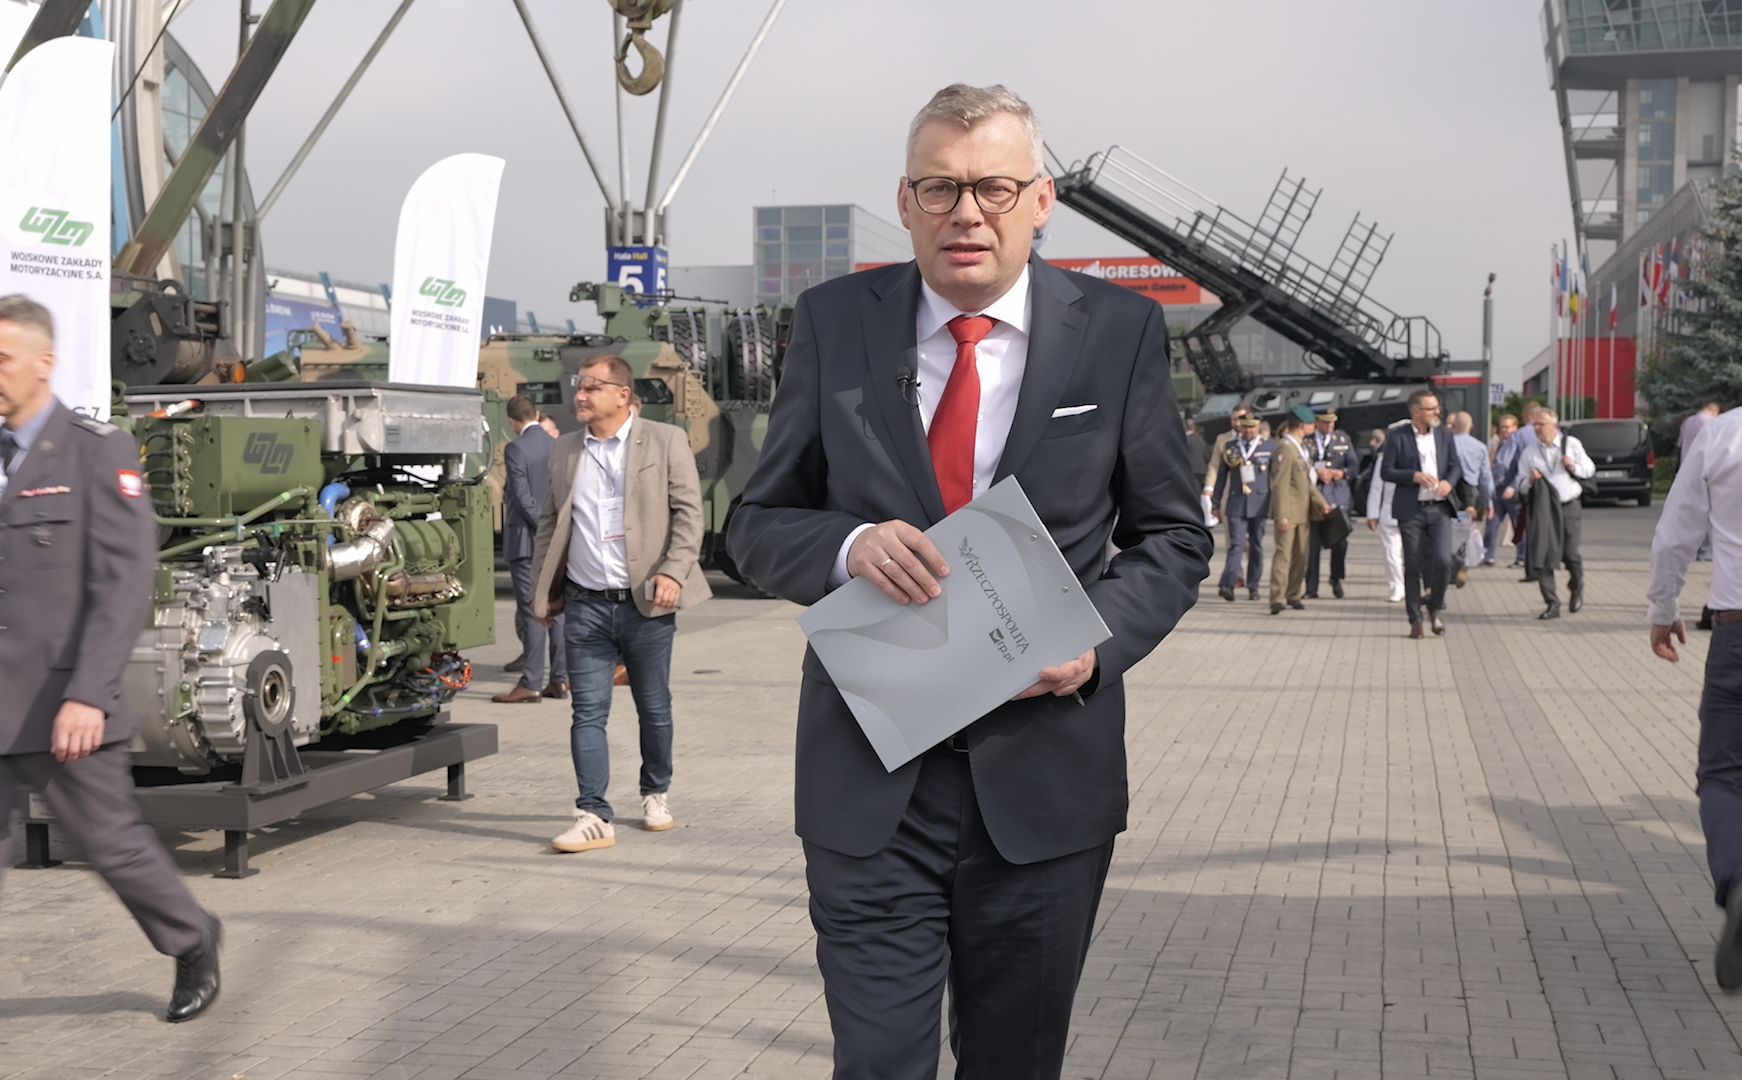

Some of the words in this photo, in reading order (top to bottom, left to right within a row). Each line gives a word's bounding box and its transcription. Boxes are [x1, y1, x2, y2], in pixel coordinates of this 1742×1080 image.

[11, 251, 58, 264] WOJSKOWE
[61, 256, 102, 268] ZAKŁADY
[10, 264, 83, 278] MOTORYZACYJNE
[618, 265, 645, 296] 5
[1071, 264, 1182, 279] NGRESOW
[965, 560, 1029, 654] RZECZPOSPOLITA
[997, 641, 1015, 663] rp.pl
